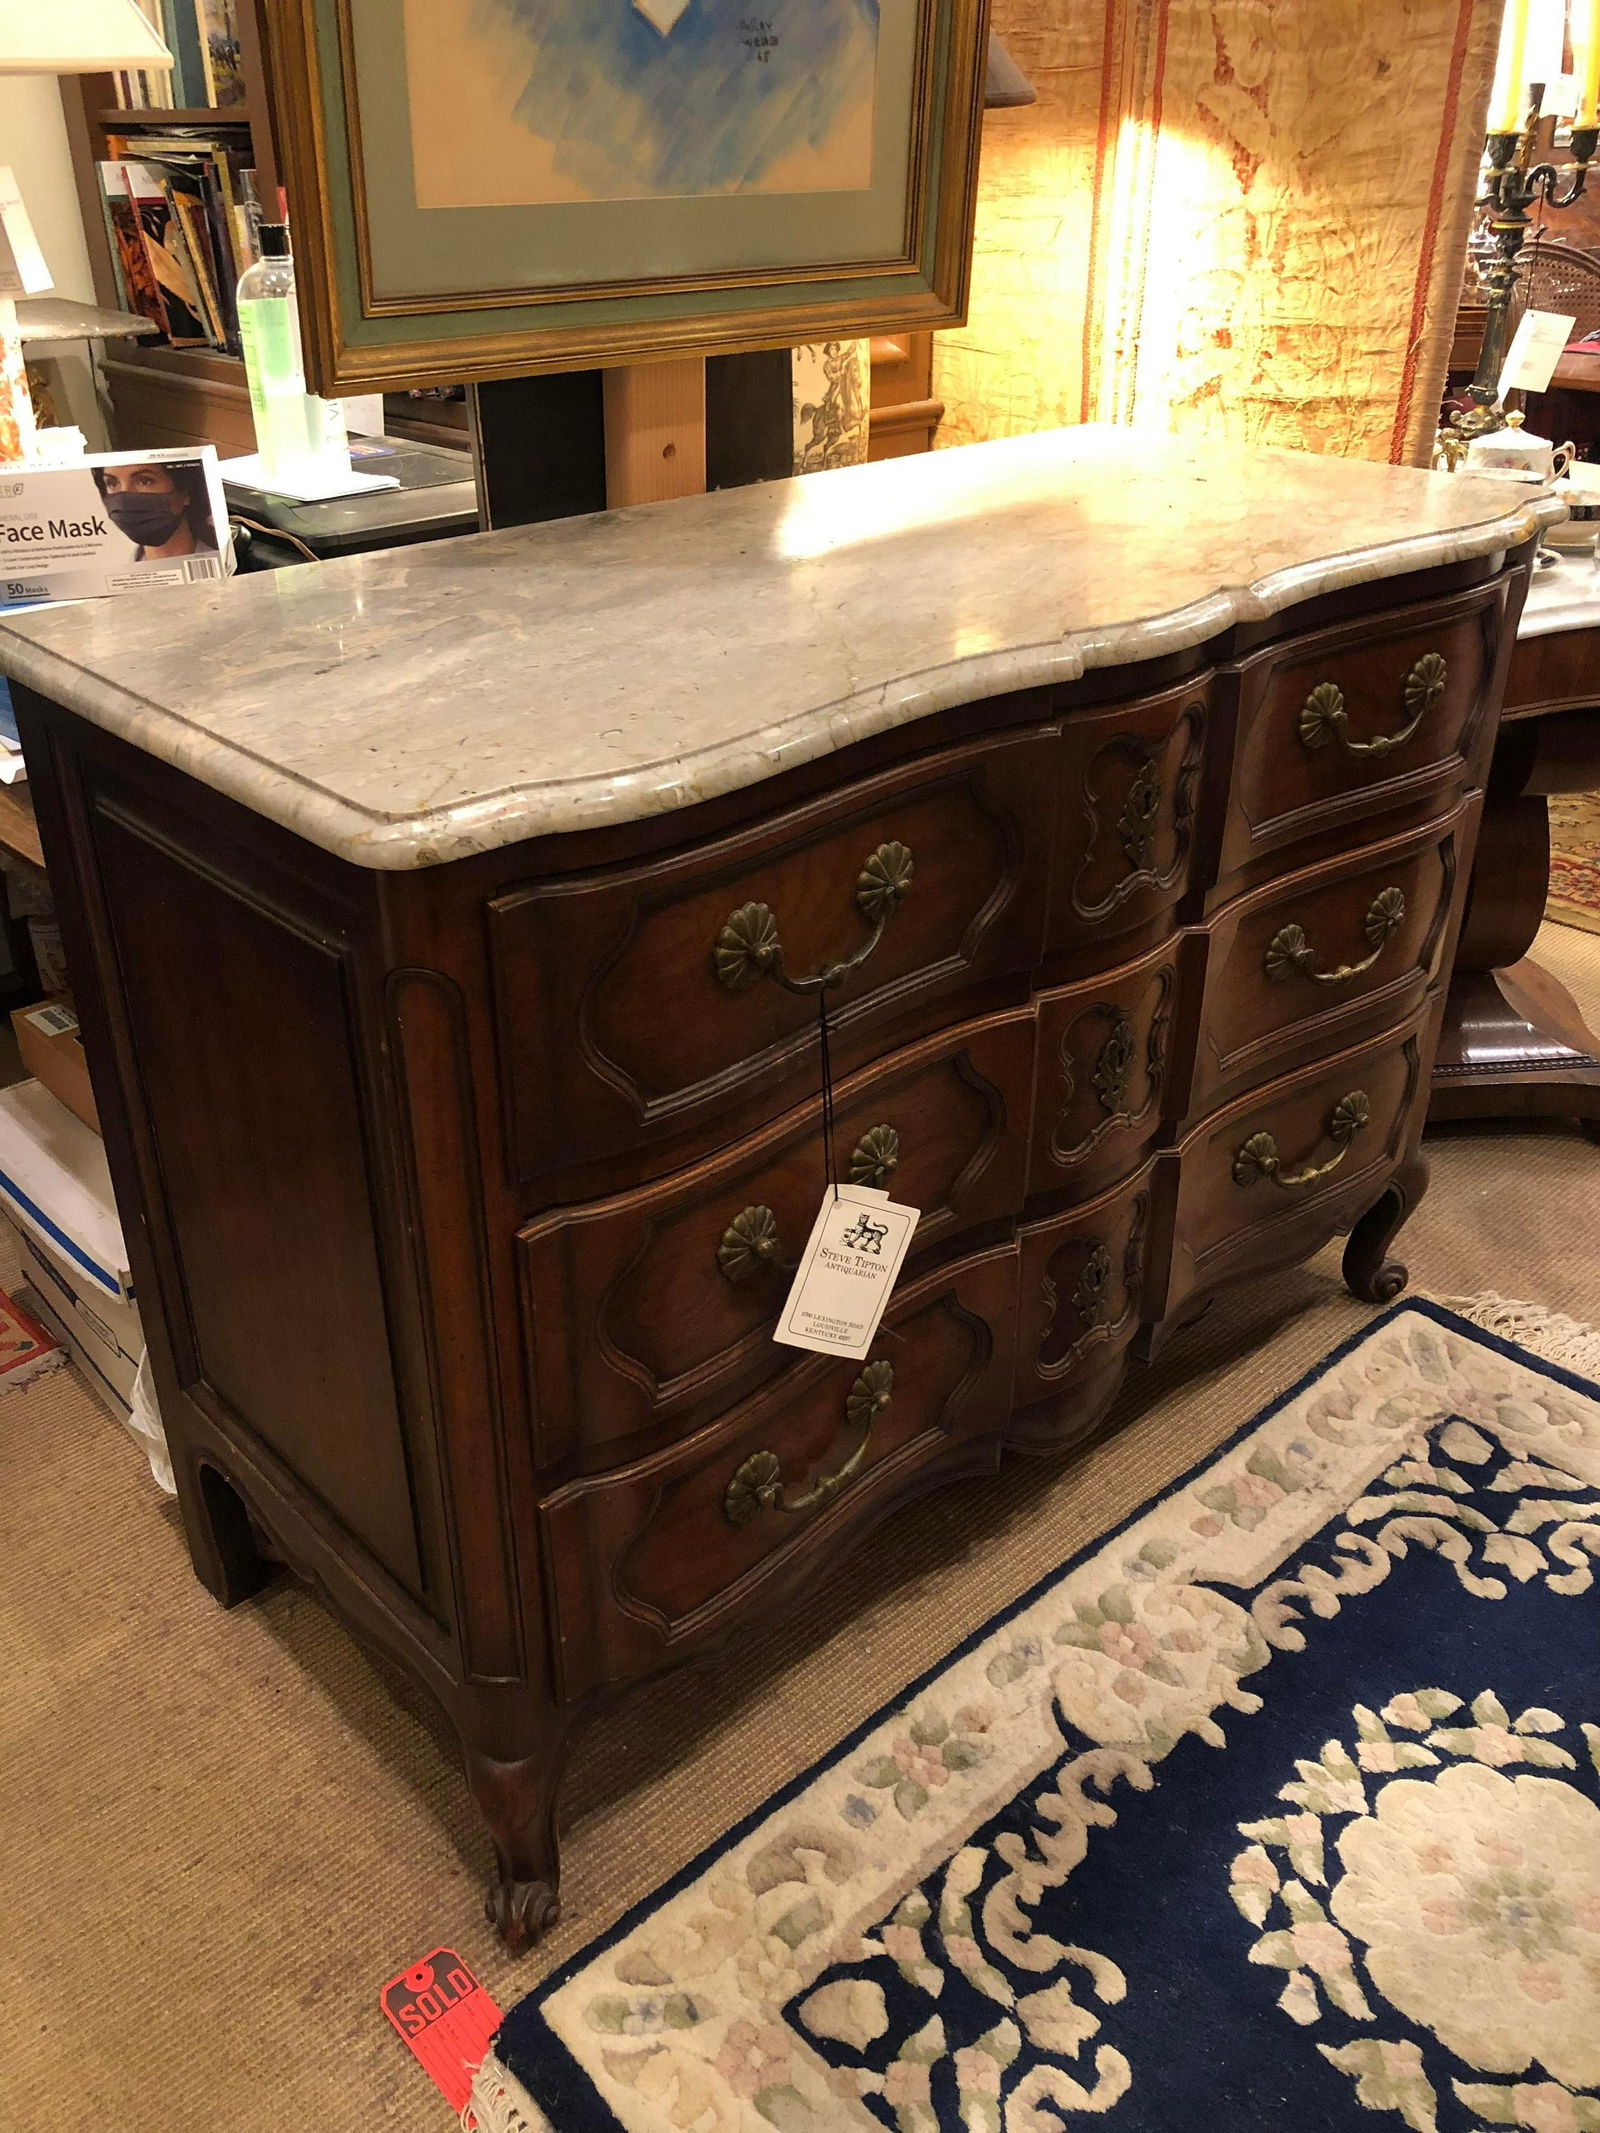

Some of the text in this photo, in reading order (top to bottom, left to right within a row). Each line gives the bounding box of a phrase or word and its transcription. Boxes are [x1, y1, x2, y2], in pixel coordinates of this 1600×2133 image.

[48, 515, 108, 540] Mask
[7, 583, 24, 595] 50
[820, 1247, 888, 1273] STEVE TIPTON
[825, 1262, 878, 1279] ANTIQUARIAN
[805, 1326, 837, 1340] KENTUCKY
[813, 1321, 849, 1334] LOUISVILLE
[399, 1968, 474, 2034] SOLD
